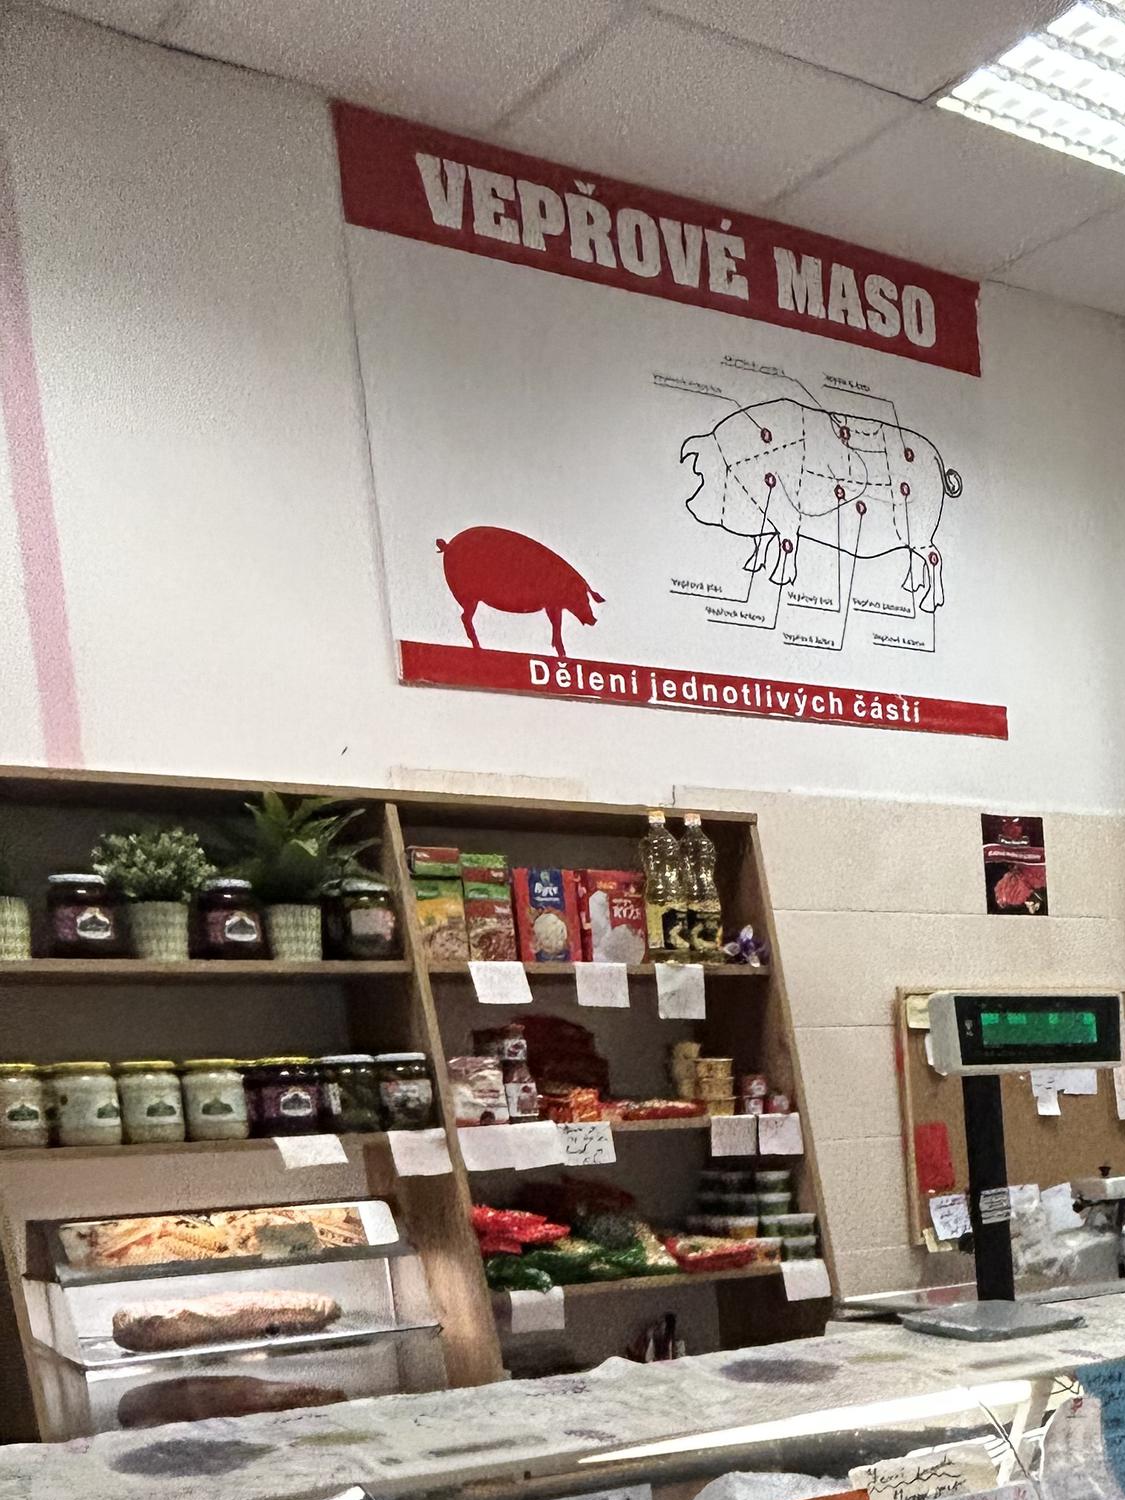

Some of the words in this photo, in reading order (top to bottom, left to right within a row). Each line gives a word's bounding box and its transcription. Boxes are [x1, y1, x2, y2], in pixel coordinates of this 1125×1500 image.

[415, 151, 750, 303] VEPŘOVÉ
[773, 246, 937, 349] MASO
[649, 672, 844, 718] jednotlivých
